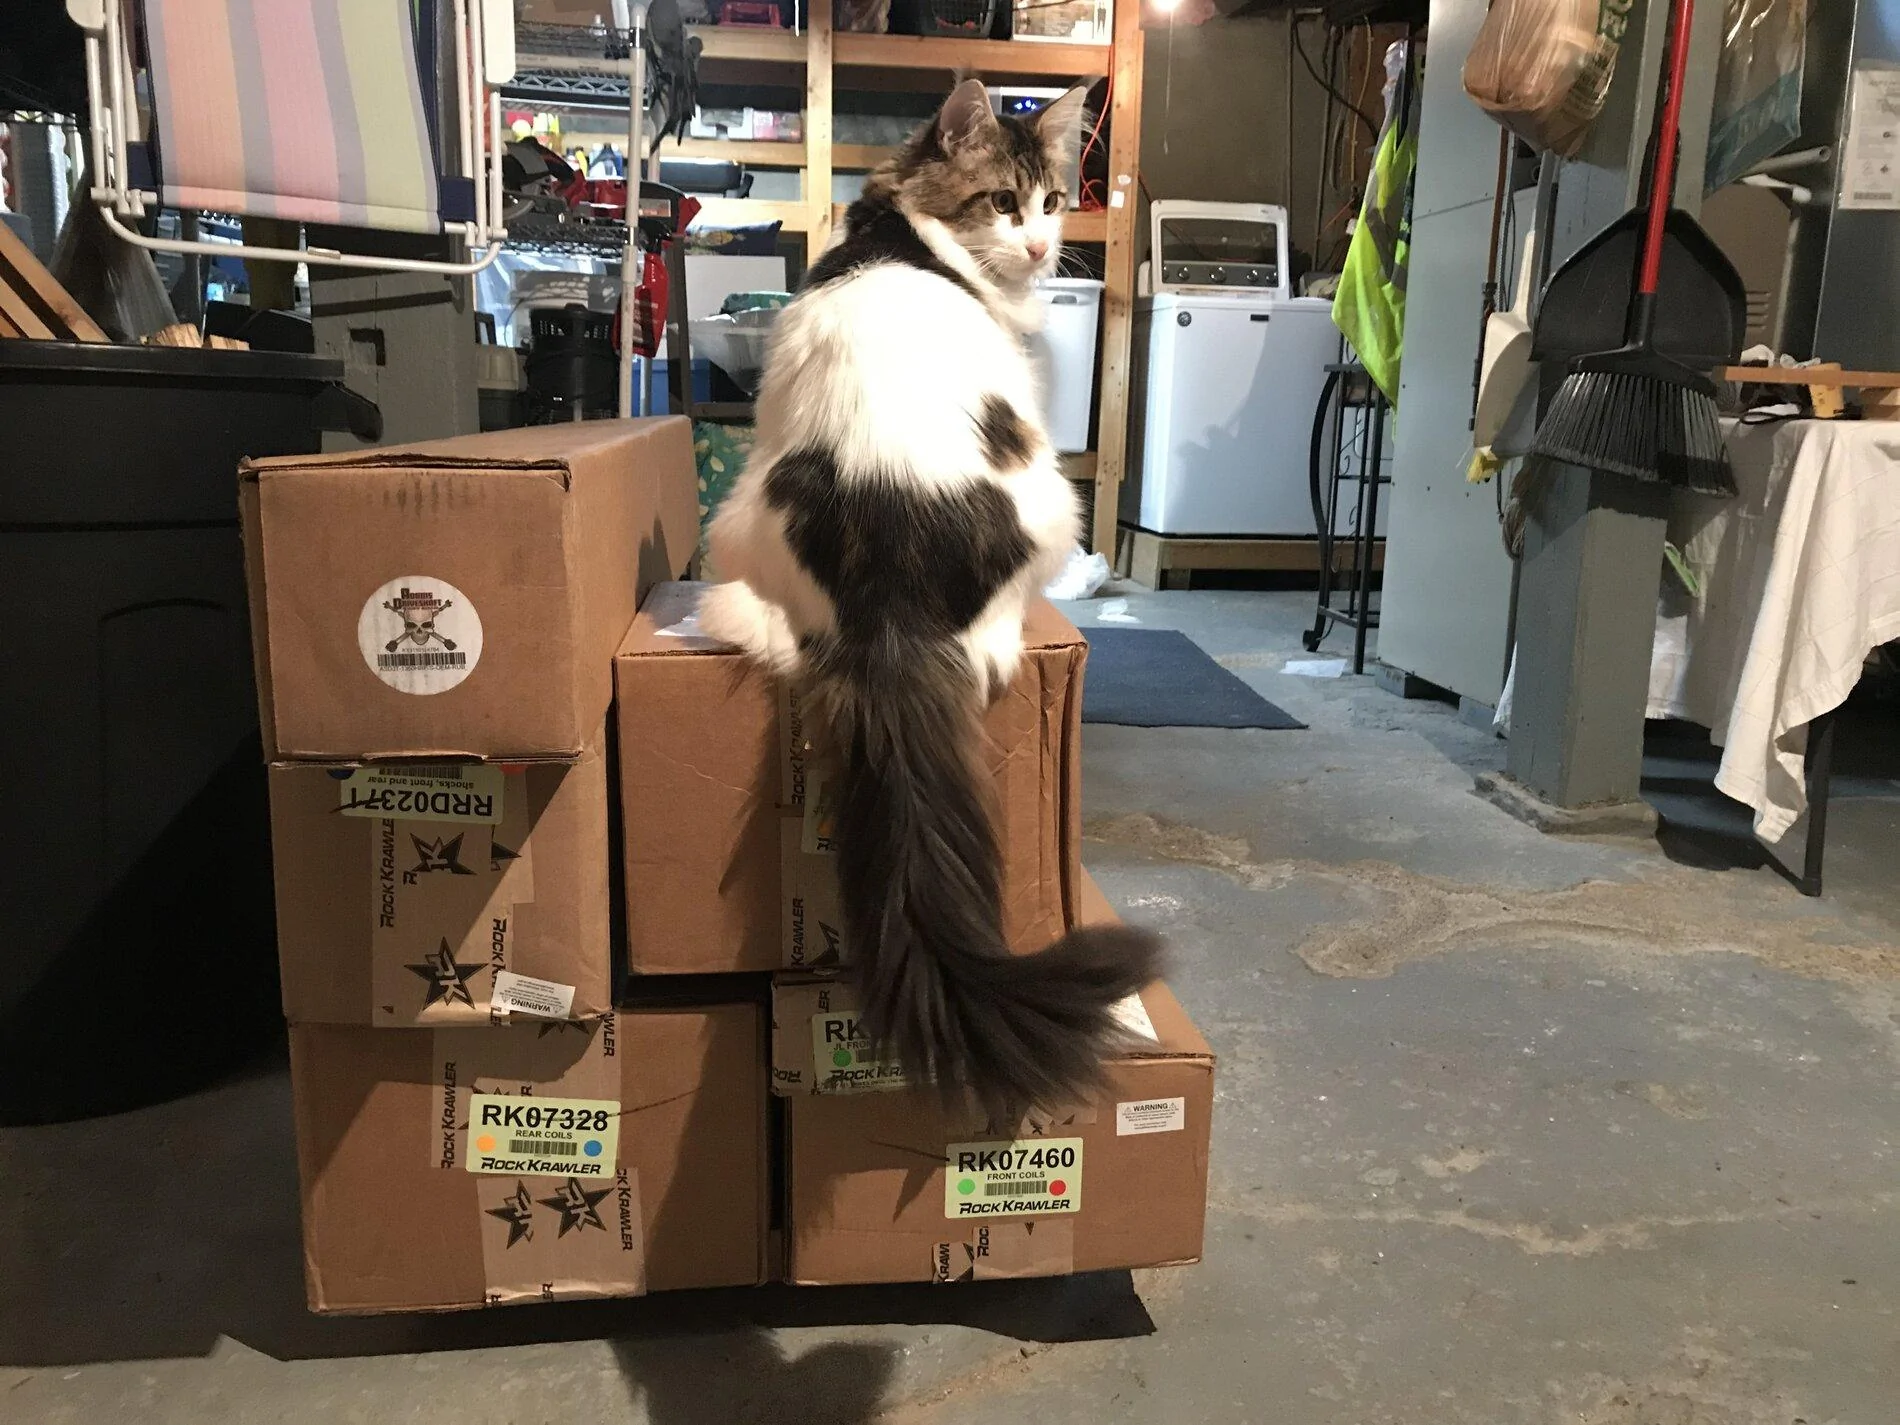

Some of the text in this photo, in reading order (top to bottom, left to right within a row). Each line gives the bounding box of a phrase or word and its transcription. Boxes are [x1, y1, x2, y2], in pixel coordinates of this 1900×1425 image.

[367, 776, 386, 784] rear
[390, 777, 407, 786] and
[411, 779, 433, 788] front
[351, 787, 493, 816] RRD02371
[510, 998, 551, 1013] WARNING
[442, 1060, 457, 1130] KRAWLER
[1133, 1102, 1168, 1112] WARNING
[481, 1103, 609, 1132] RK07328
[515, 1129, 573, 1140] REAR COILS
[481, 1156, 601, 1175] ROCK KRAWLER
[958, 1147, 1075, 1173] RK07460
[987, 1170, 1046, 1181] FRONT COILS
[959, 1199, 1070, 1215] ROCK KRAWLER
[617, 1186, 634, 1251] KRAWLER
[976, 1226, 990, 1257] ROC
